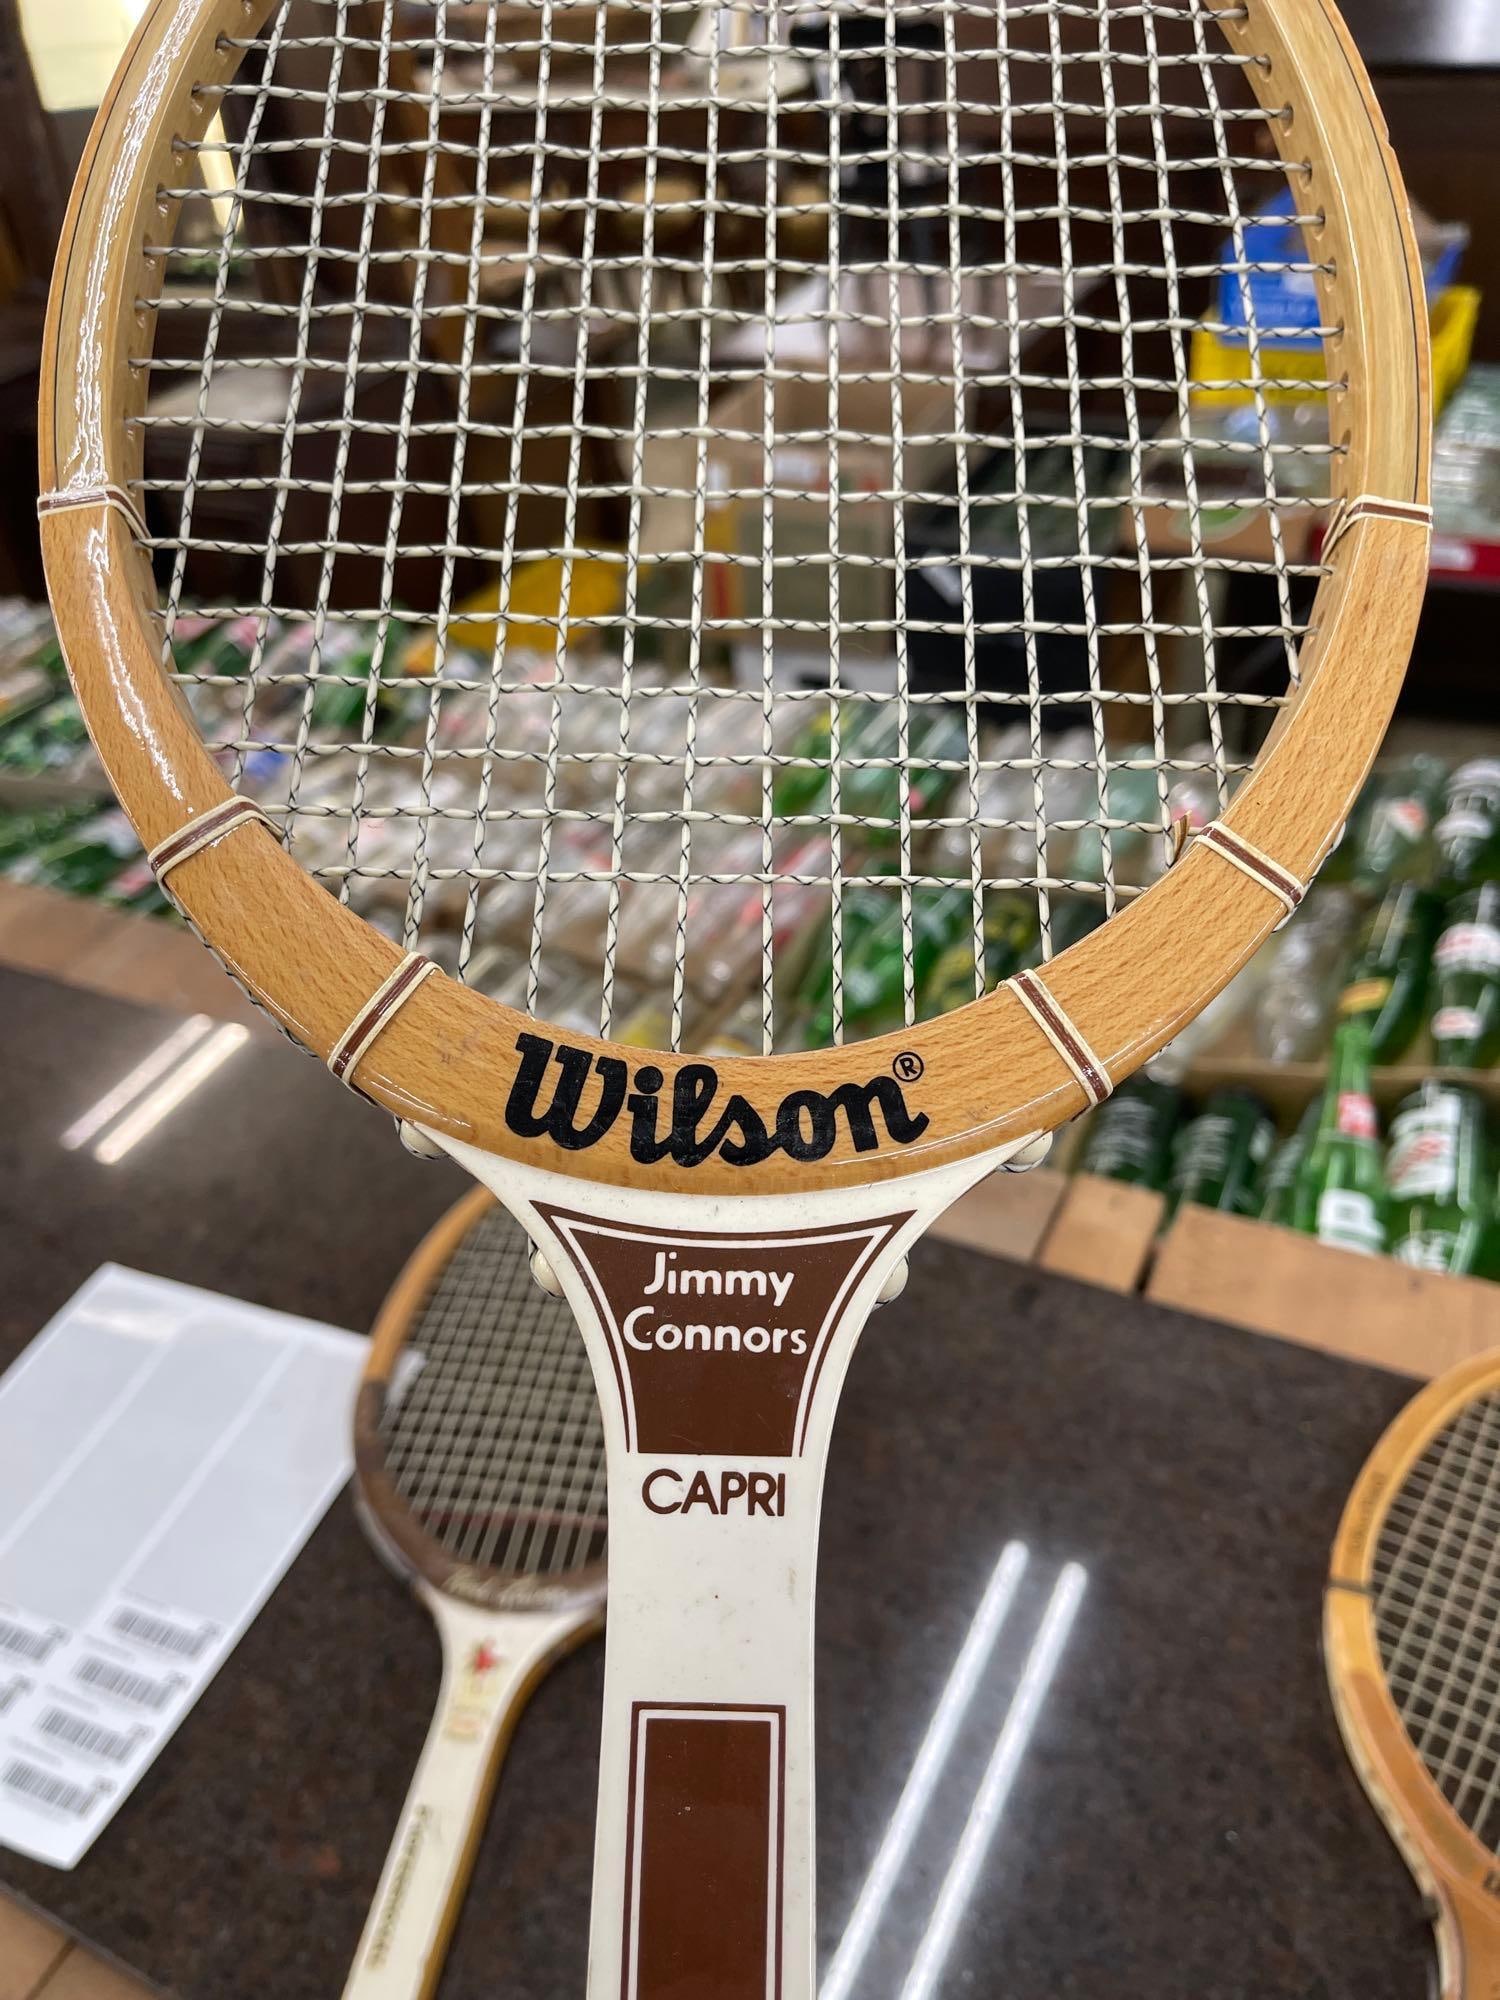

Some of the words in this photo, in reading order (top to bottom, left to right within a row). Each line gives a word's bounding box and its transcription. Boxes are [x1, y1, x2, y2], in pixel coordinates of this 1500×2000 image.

[505, 1032, 930, 1168] Wilson
[643, 1251, 795, 1306] Jimmy
[623, 1306, 807, 1355] Connors
[641, 1468, 785, 1517] CAPRI
